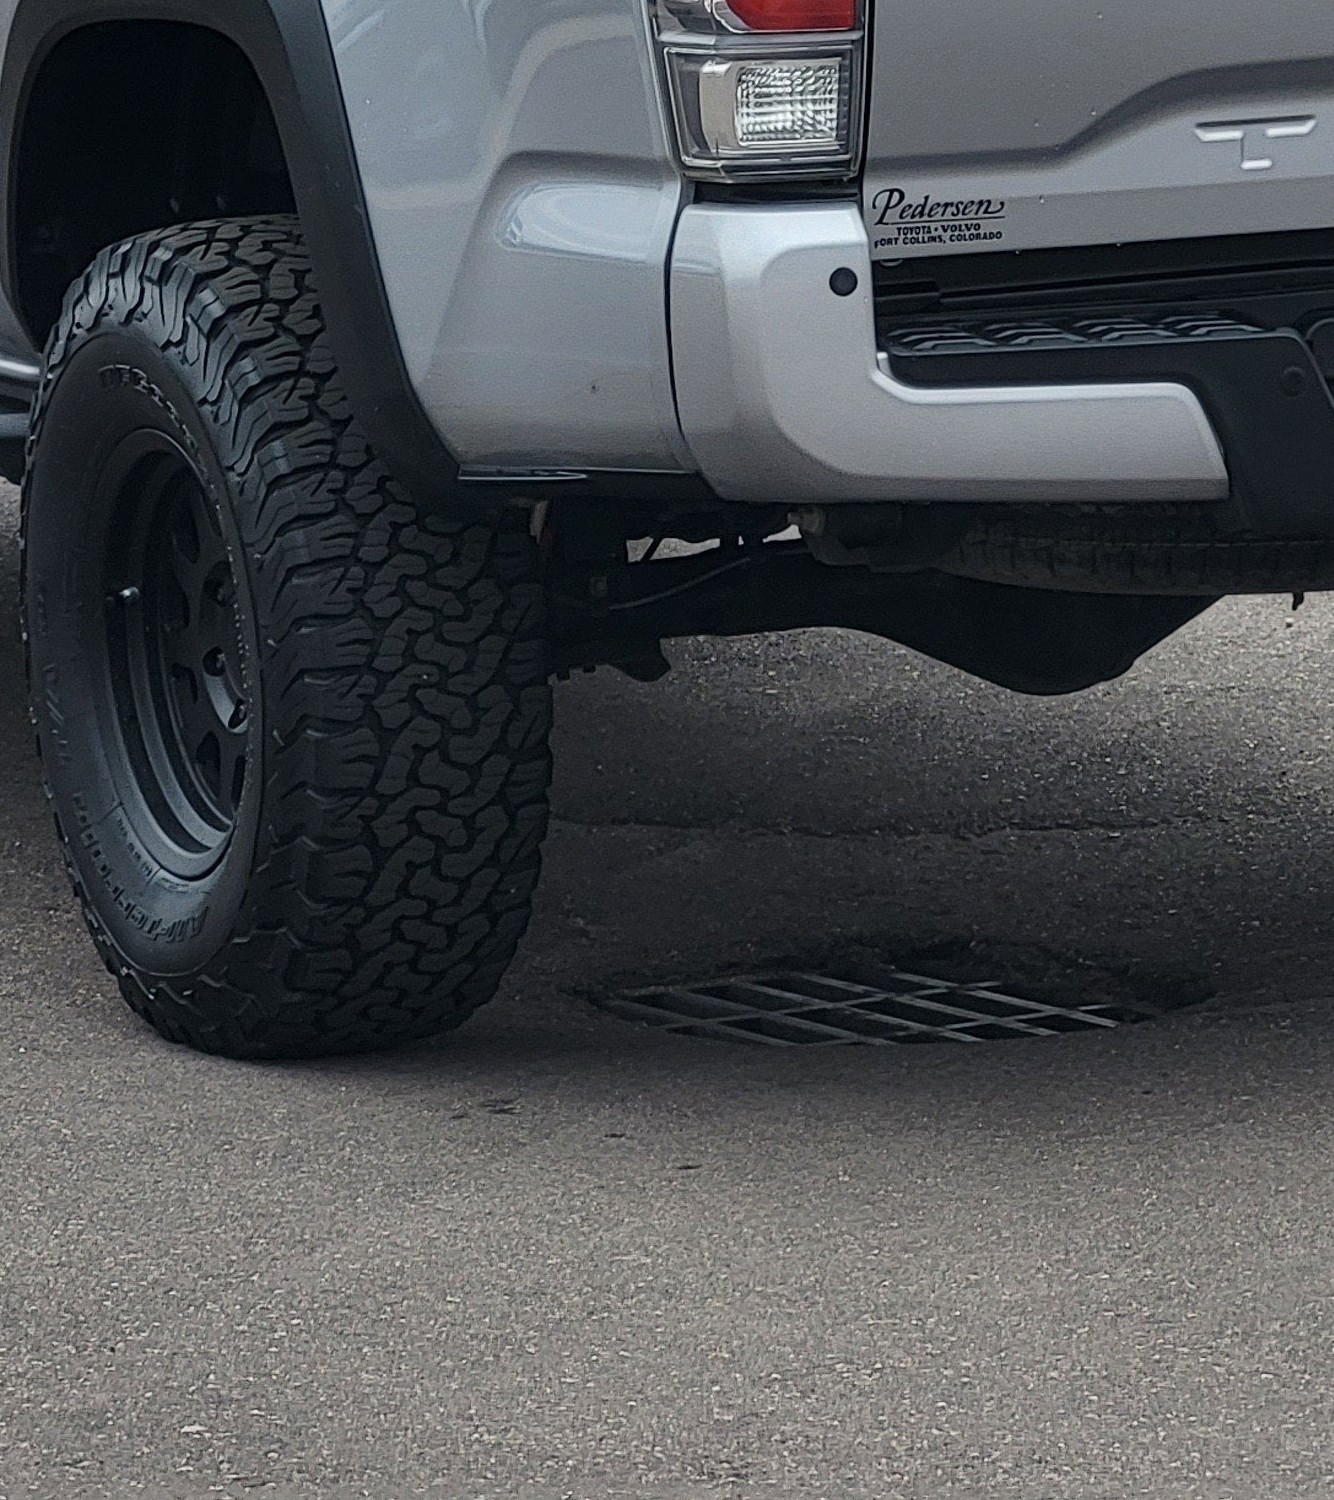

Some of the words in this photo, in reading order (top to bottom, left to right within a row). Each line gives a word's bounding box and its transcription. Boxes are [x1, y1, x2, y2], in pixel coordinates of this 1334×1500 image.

[872, 187, 1005, 226] Pedersen
[896, 225, 932, 237] TOYOTA
[941, 223, 981, 234] VOLVO
[874, 237, 898, 249] FORT
[949, 231, 1003, 243] COLORADO
